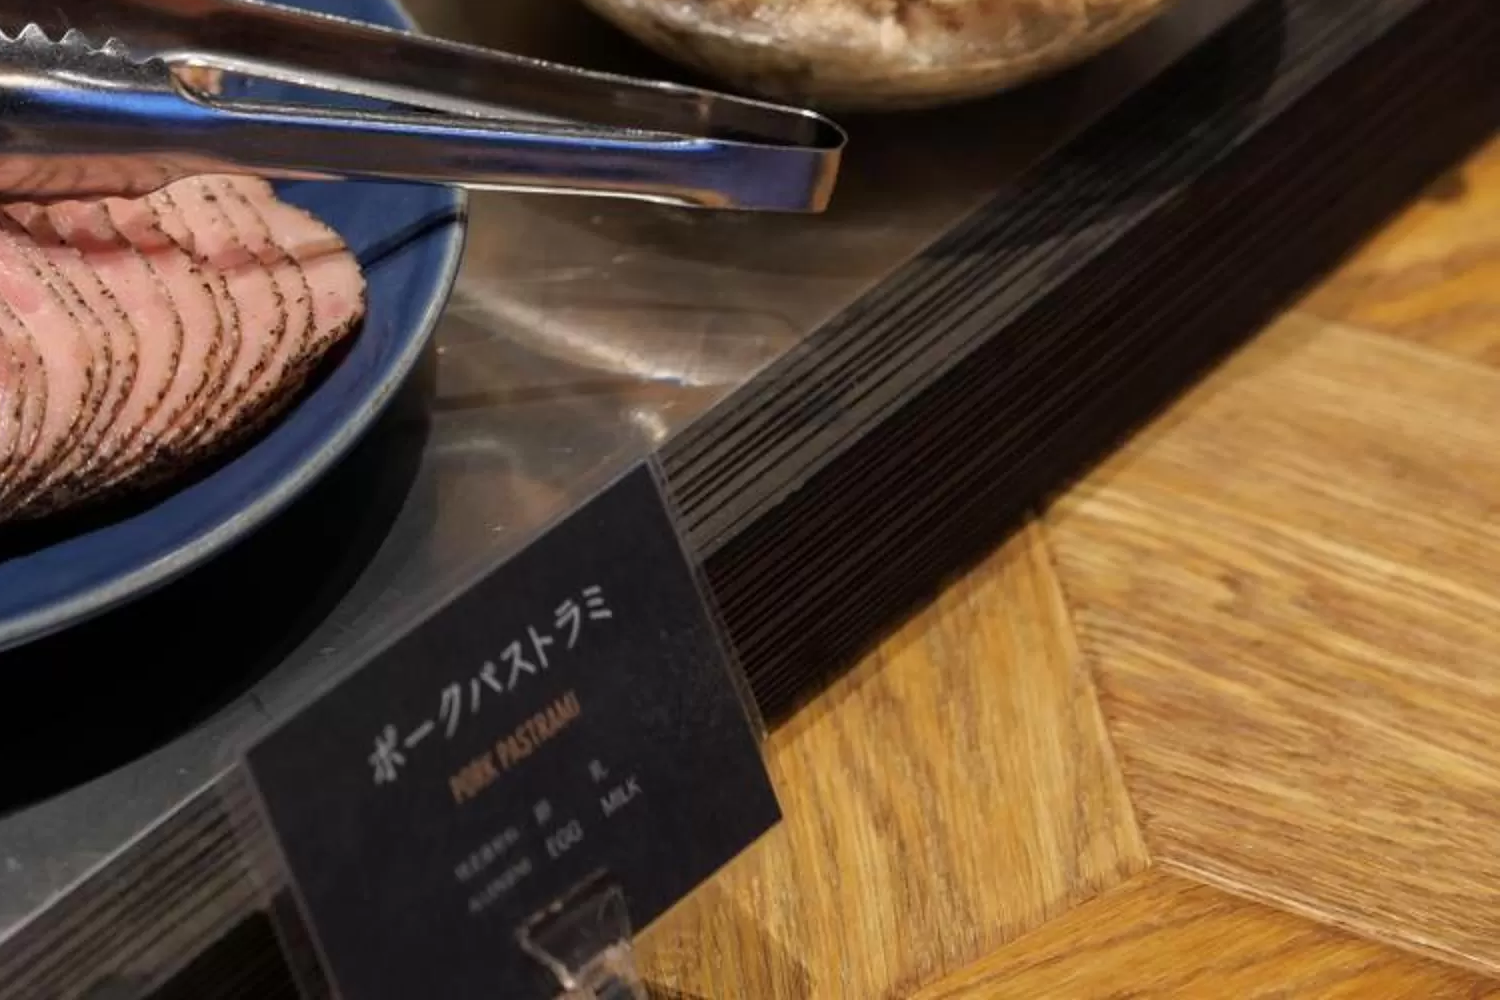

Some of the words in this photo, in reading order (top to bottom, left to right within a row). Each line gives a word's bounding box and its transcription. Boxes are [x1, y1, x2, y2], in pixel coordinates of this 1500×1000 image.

[367, 584, 613, 786] ポークパストラミ
[495, 688, 581, 770] PASTRAMI
